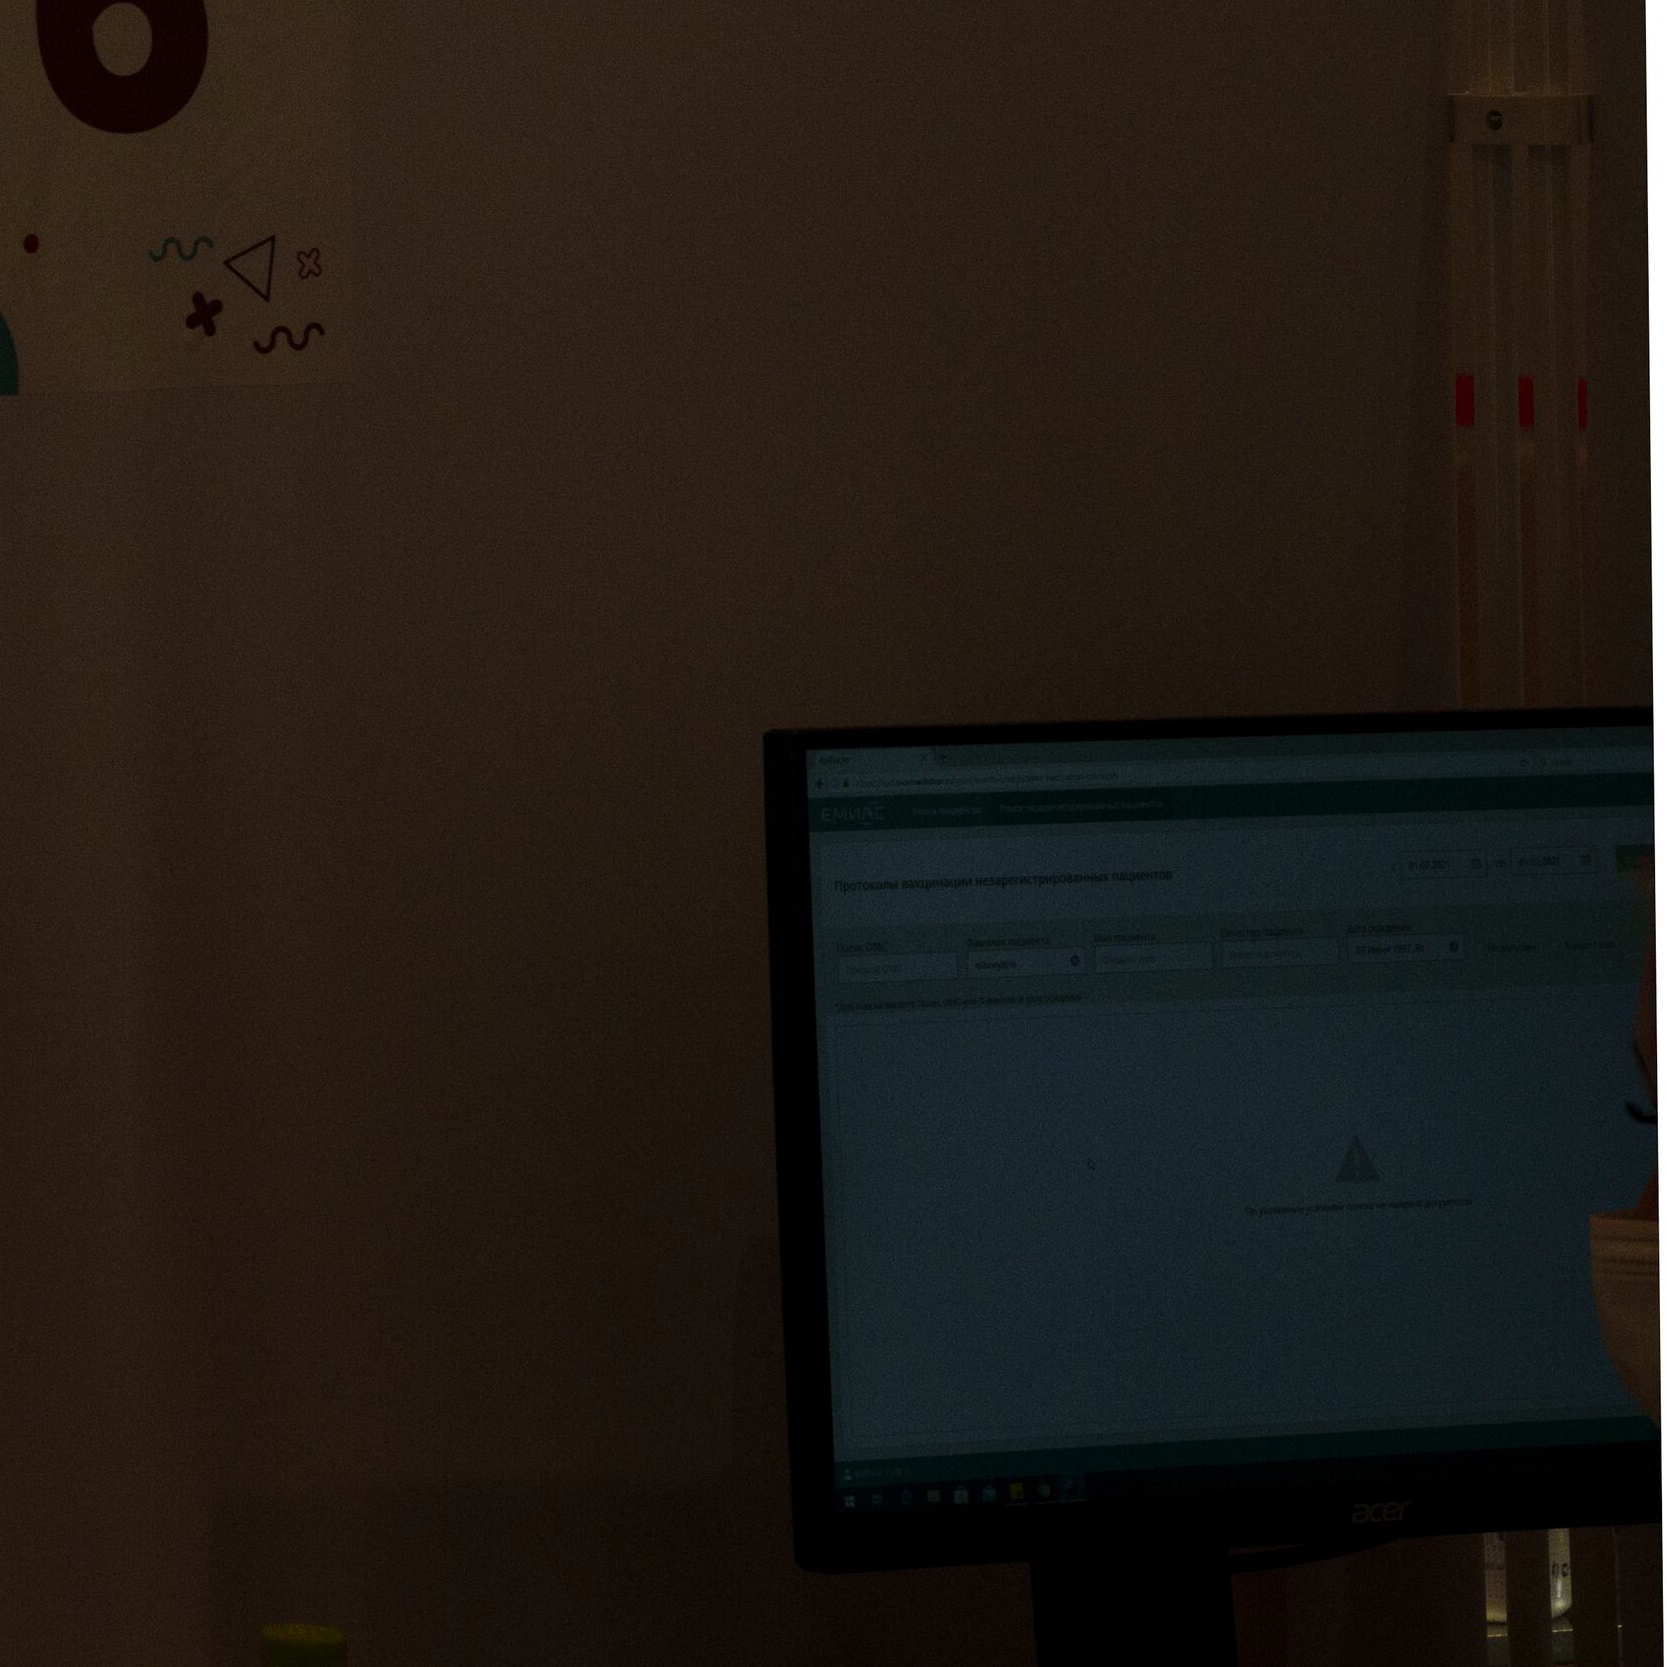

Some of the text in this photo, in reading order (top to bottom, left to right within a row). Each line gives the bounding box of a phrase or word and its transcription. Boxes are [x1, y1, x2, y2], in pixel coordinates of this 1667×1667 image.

[821, 804, 885, 822] ЕМИАС
[834, 868, 1173, 894] Протоколы вакцинации незарегистрированных пациентов
[1352, 1500, 1412, 1524] acer
